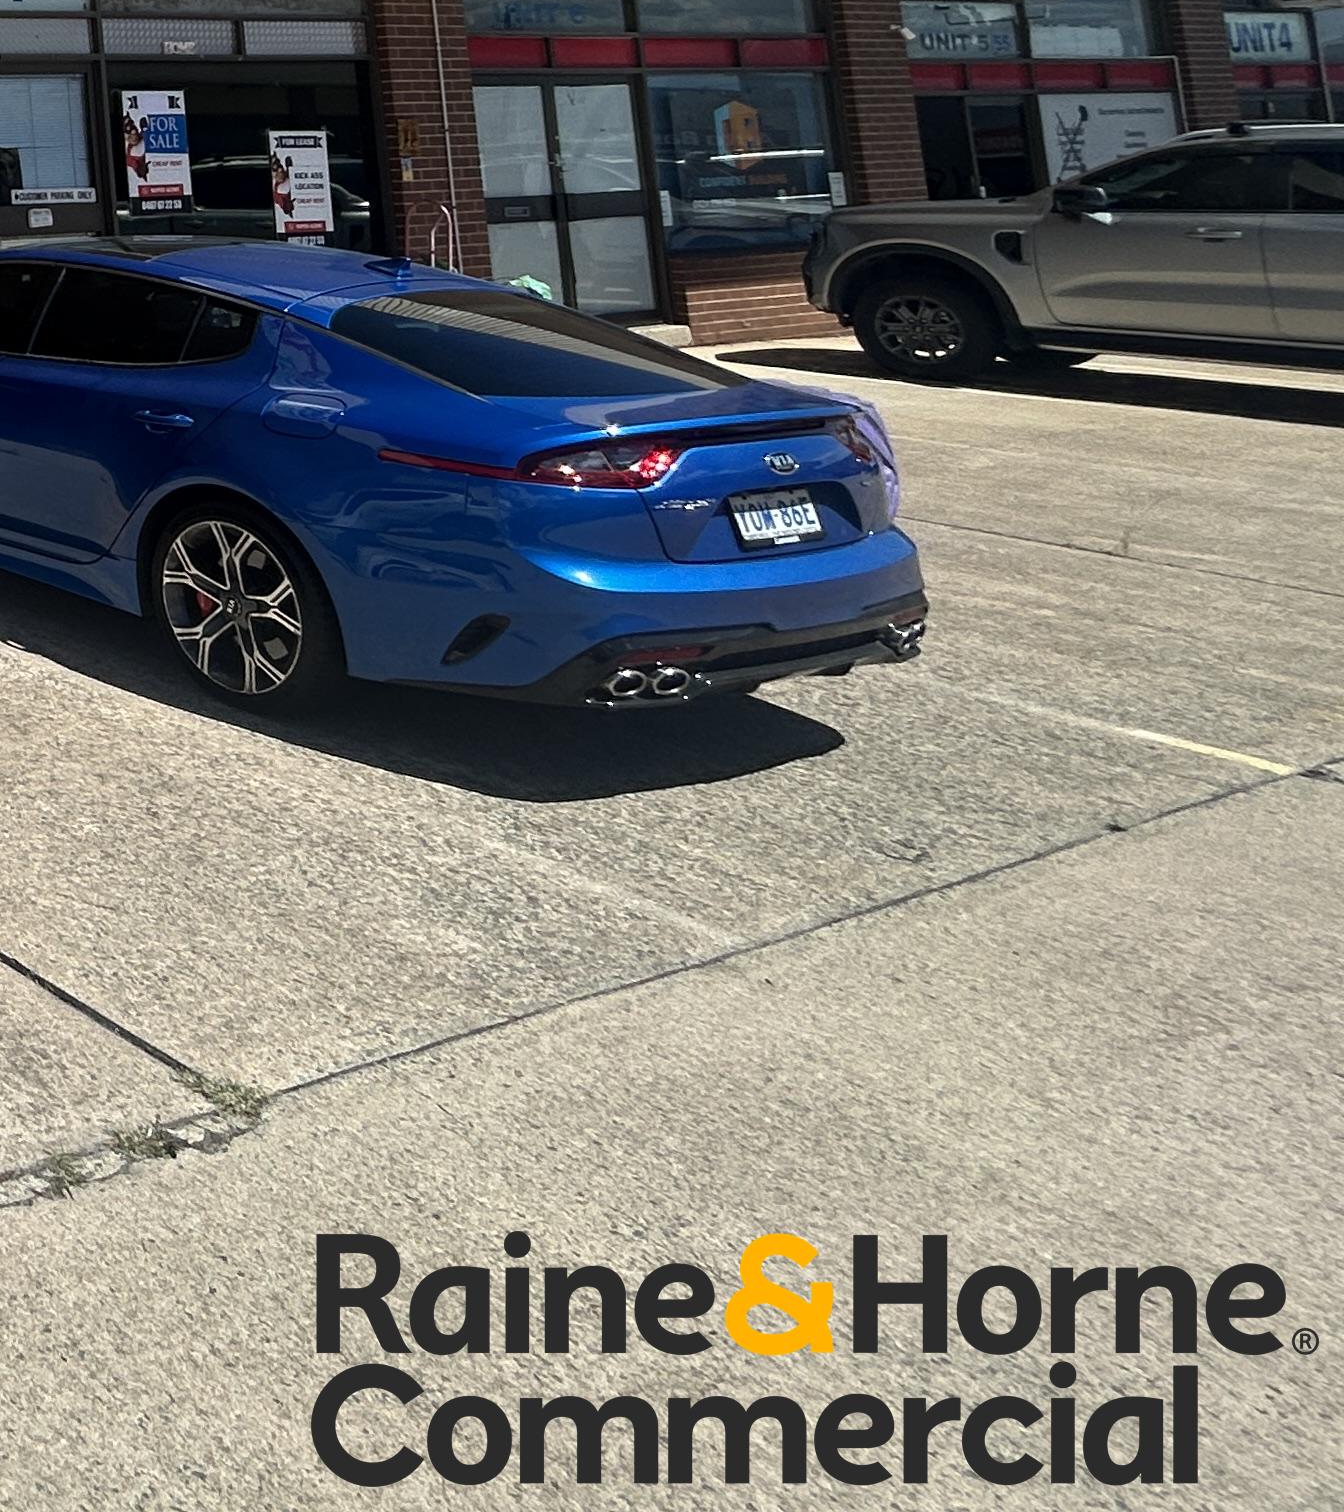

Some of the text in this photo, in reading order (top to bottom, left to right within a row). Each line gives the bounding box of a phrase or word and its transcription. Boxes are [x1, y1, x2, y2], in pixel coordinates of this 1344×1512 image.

[920, 33, 970, 51] UNIT
[150, 116, 178, 133] FOR
[149, 133, 180, 149] SALE
[311, 171, 324, 179] ASS
[294, 182, 325, 191] LOCATION
